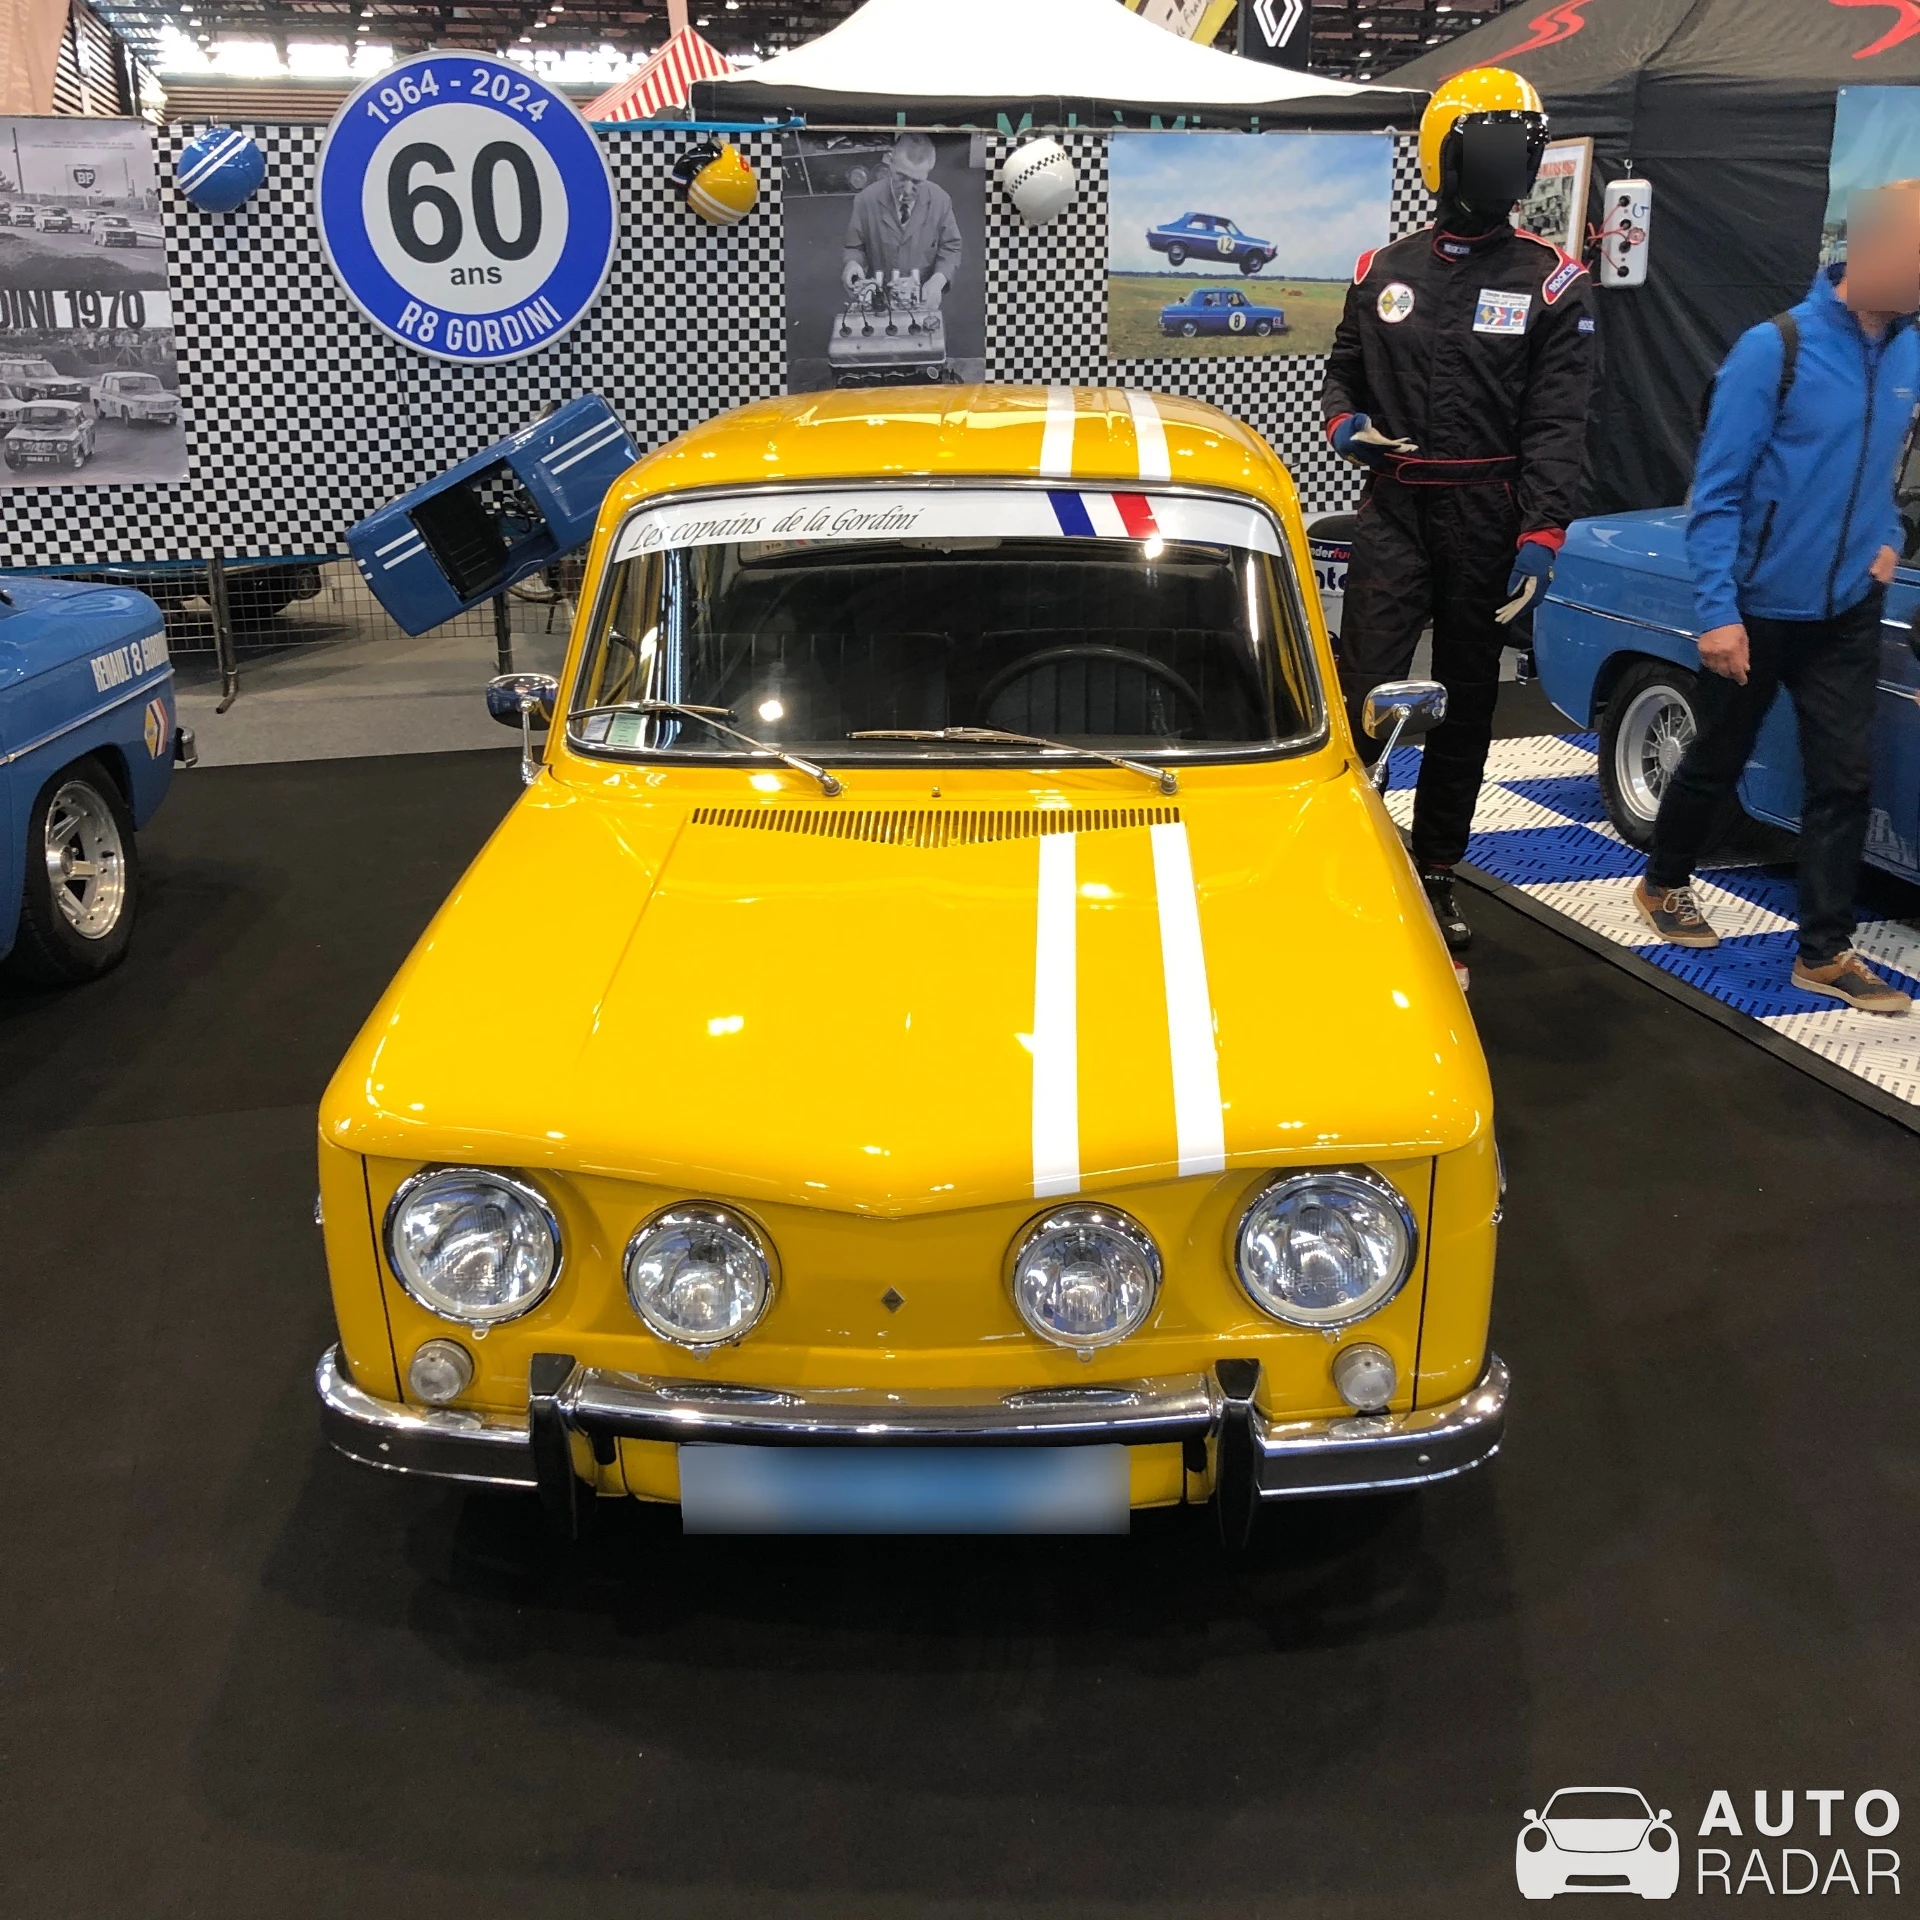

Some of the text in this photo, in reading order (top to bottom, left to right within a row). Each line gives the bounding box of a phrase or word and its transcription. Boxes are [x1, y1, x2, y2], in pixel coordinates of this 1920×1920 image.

[367, 69, 440, 125] 1964
[469, 68, 550, 123] 2024
[387, 140, 542, 264] 60
[1219, 237, 1233, 252] 12
[450, 265, 503, 286] ans
[65, 289, 146, 329] 1970
[397, 295, 563, 352] R8 GORDINI
[1233, 314, 1241, 329] 8
[628, 505, 925, 552] Les copains de la Gordini
[90, 646, 133, 692] RENAULT
[130, 642, 144, 675] 8
